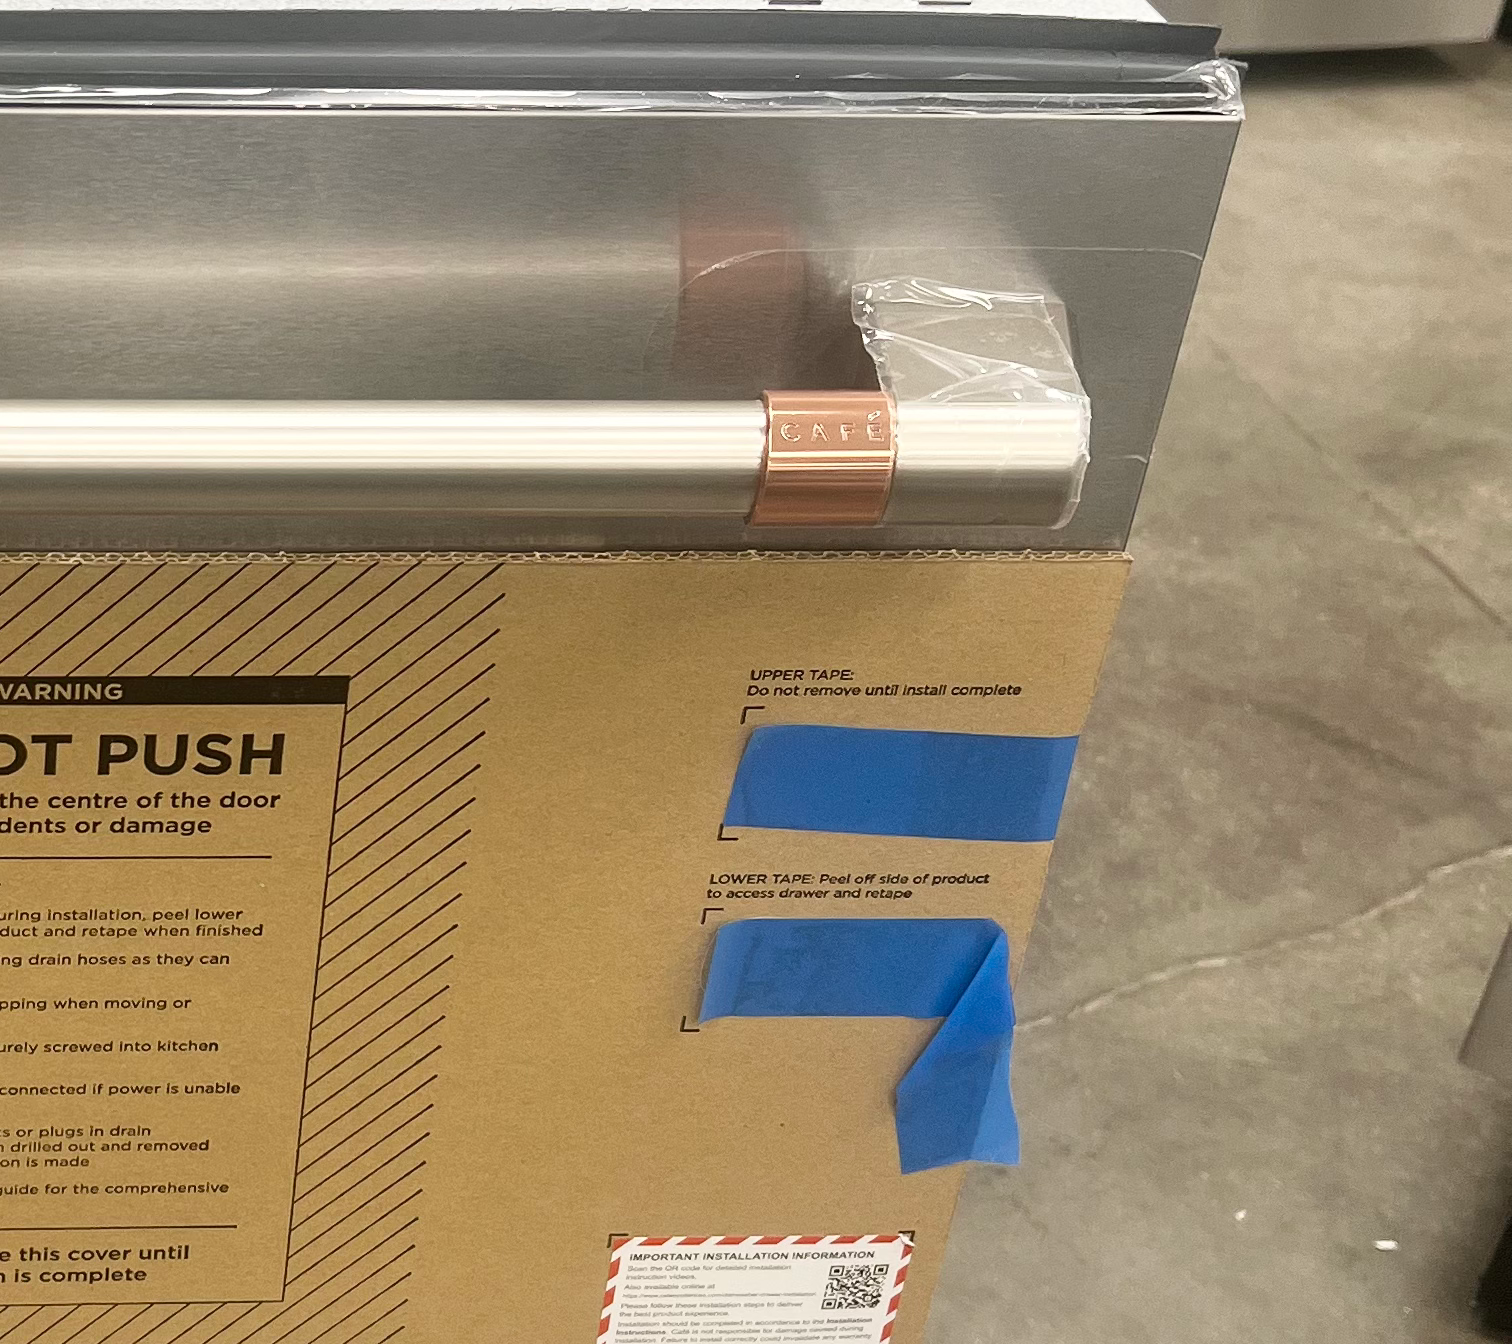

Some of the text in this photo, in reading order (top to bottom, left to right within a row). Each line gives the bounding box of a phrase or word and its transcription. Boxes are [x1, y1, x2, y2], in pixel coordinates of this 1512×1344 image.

[780, 410, 885, 442] CAFÉ
[750, 669, 854, 681] UPPER TAPE:
[747, 684, 1022, 697] Do not remove until install complete
[97, 733, 285, 776] PUSH
[0, 792, 39, 809] the
[48, 793, 128, 809] centre
[136, 791, 164, 808] of
[170, 792, 211, 808] the
[220, 791, 281, 808] door
[75, 821, 102, 833] or
[110, 816, 212, 836] damage
[709, 873, 990, 886] LOWER TAPE: Peel off side of product
[707, 888, 913, 900] to access drawer and retape
[47, 909, 146, 921] installation,
[152, 908, 189, 922] peel
[195, 908, 243, 920] lower
[44, 925, 76, 937] and
[82, 926, 137, 938] retape
[144, 925, 189, 936] when
[196, 924, 264, 936] finished
[53, 997, 98, 1009] when
[104, 997, 167, 1011] moving
[173, 999, 192, 1009] or
[45, 1184, 68, 1194] for
[73, 1183, 99, 1194] the
[105, 1182, 229, 1195] comprehensive
[19, 1247, 60, 1262] this
[68, 1249, 132, 1261] cover
[139, 1245, 189, 1260] until
[630, 1251, 875, 1261] IMPORTANT INSTALLATION INFORMATION
[14, 1269, 31, 1283] is
[39, 1267, 147, 1284] complete
